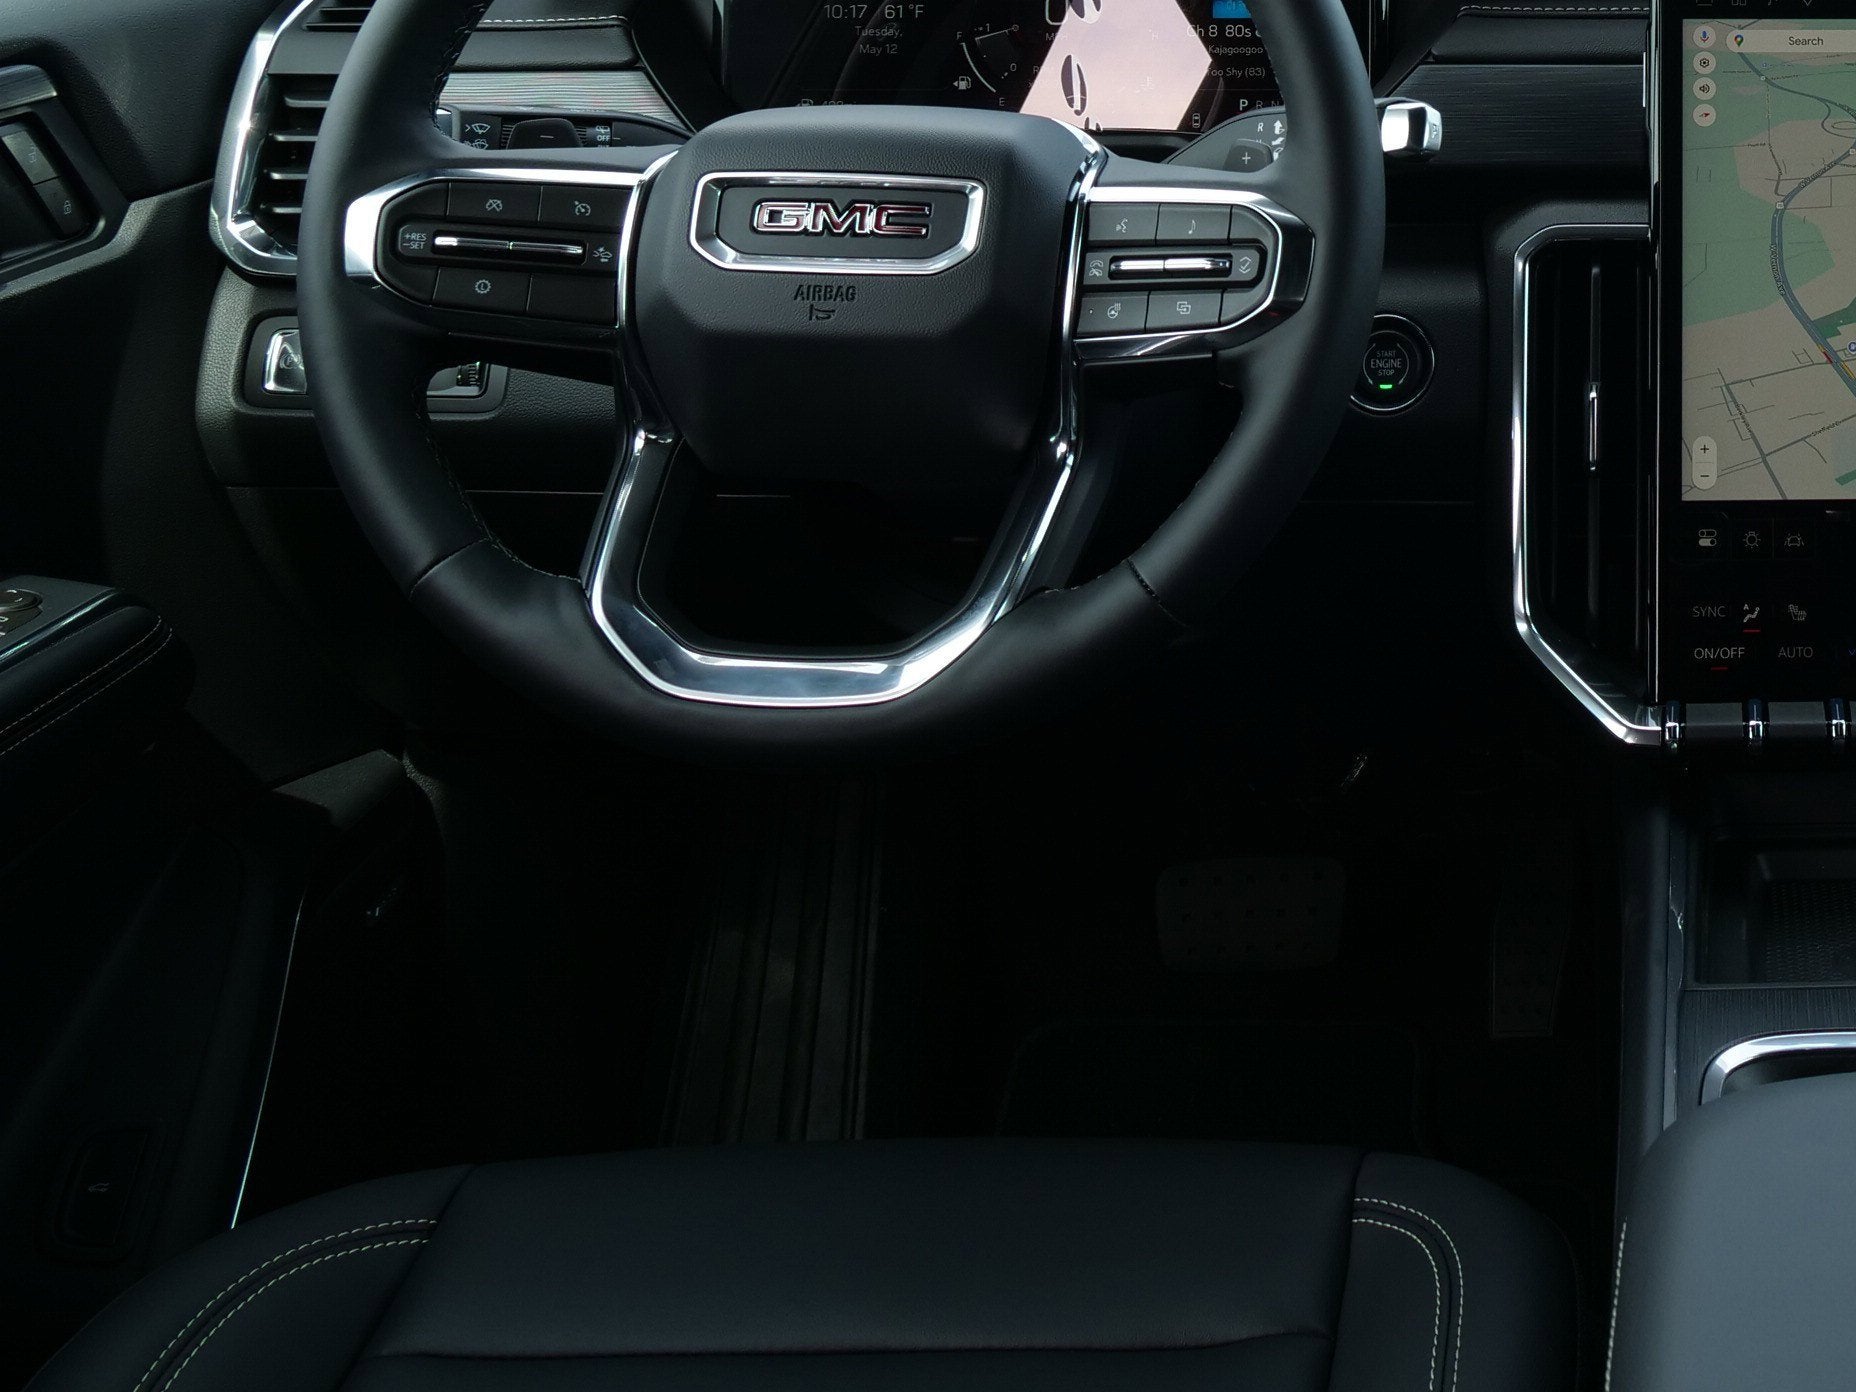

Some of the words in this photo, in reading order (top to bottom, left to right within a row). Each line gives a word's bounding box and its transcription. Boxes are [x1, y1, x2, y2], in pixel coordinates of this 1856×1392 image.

[824, 4, 868, 19] 10:17
[855, 26, 903, 38] Tuesday,
[957, 32, 962, 40] F
[1209, 25, 1218, 37] 8
[1225, 25, 1251, 37] 80s
[1788, 37, 1824, 46] Search
[859, 44, 882, 56] May
[885, 44, 898, 54] 12
[1208, 45, 1264, 56] Kajagoogoo
[1227, 67, 1243, 77] Shy
[1245, 67, 1265, 77] (83)
[999, 98, 1005, 106] E
[1239, 99, 1248, 111] P
[1258, 123, 1264, 132] R
[753, 200, 931, 235] GMC
[794, 285, 856, 303] AIRBAG
[1370, 358, 1402, 369] ENGINE
[1692, 606, 1727, 618] SYNC
[1694, 646, 1746, 659] ON/OFF
[1778, 646, 1814, 658] AUTO
